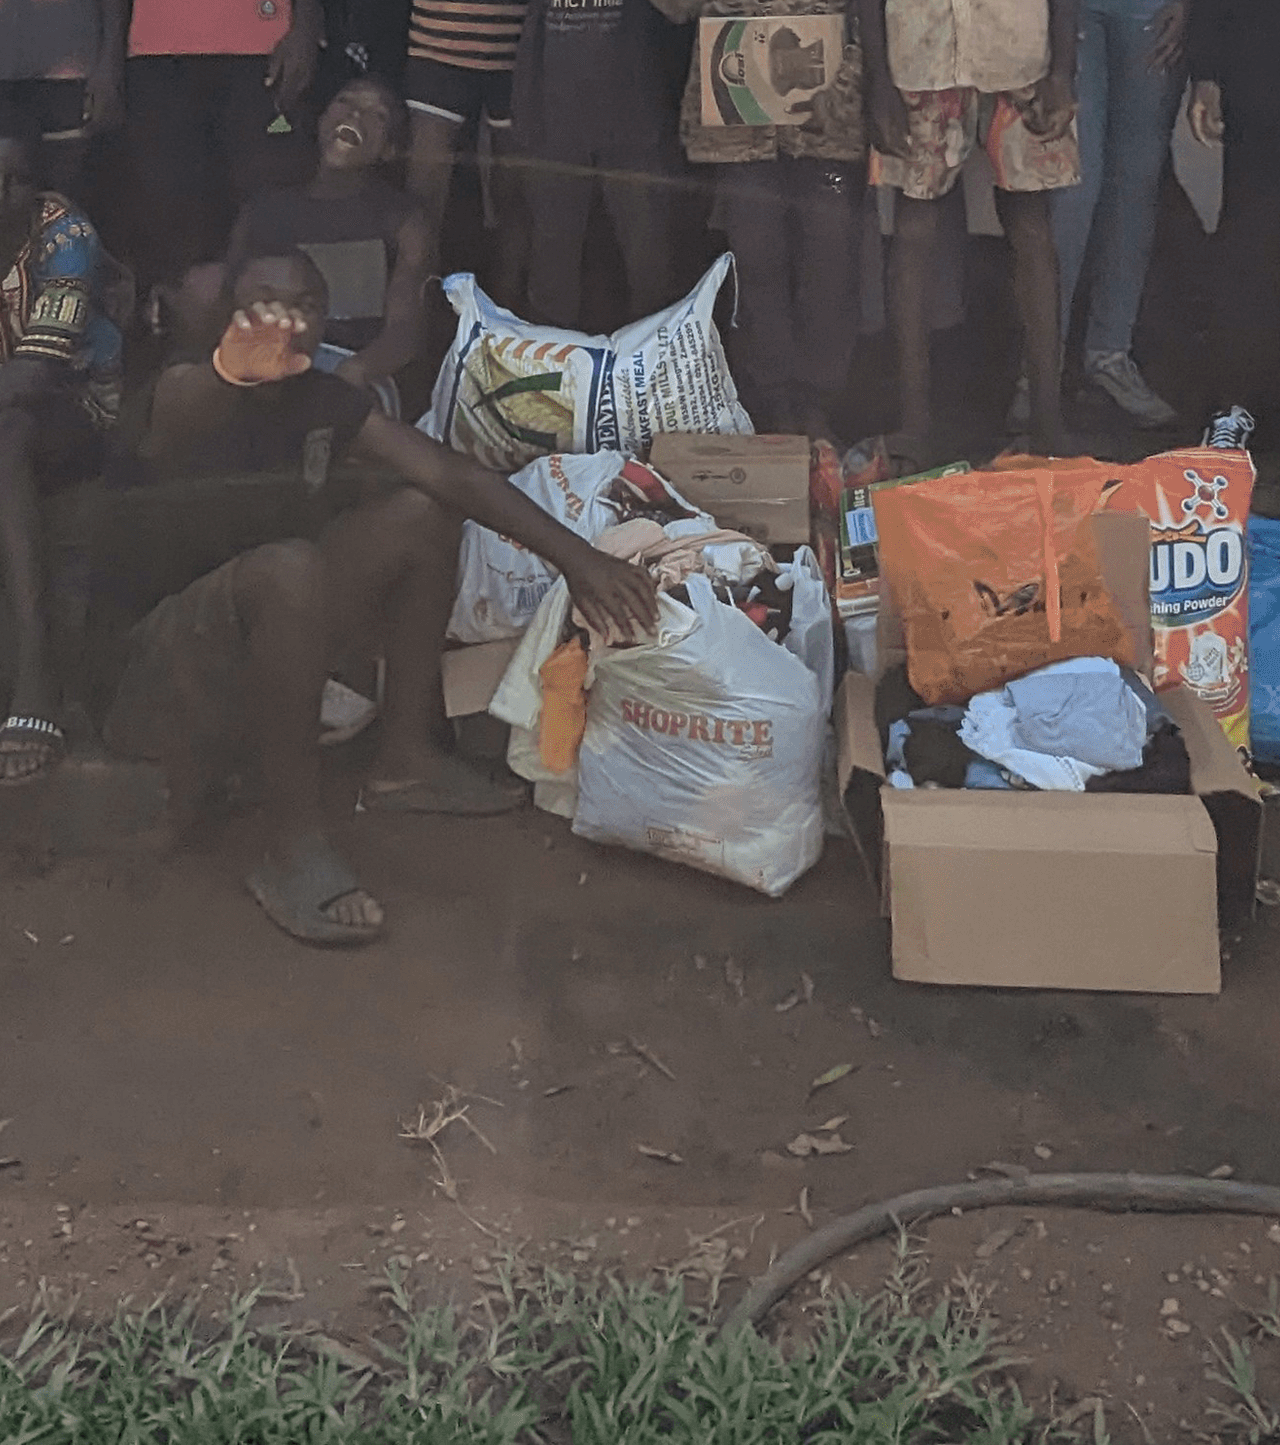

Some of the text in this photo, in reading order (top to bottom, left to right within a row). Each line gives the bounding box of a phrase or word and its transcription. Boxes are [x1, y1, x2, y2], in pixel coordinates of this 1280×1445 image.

[657, 326, 669, 349] LTD
[633, 350, 646, 388] MEAL
[657, 360, 674, 399] MILLS
[672, 358, 687, 393] Mungwi
[1149, 531, 1242, 592] UDO
[1183, 596, 1228, 611] Powder
[622, 698, 774, 746] SHOPRITE
